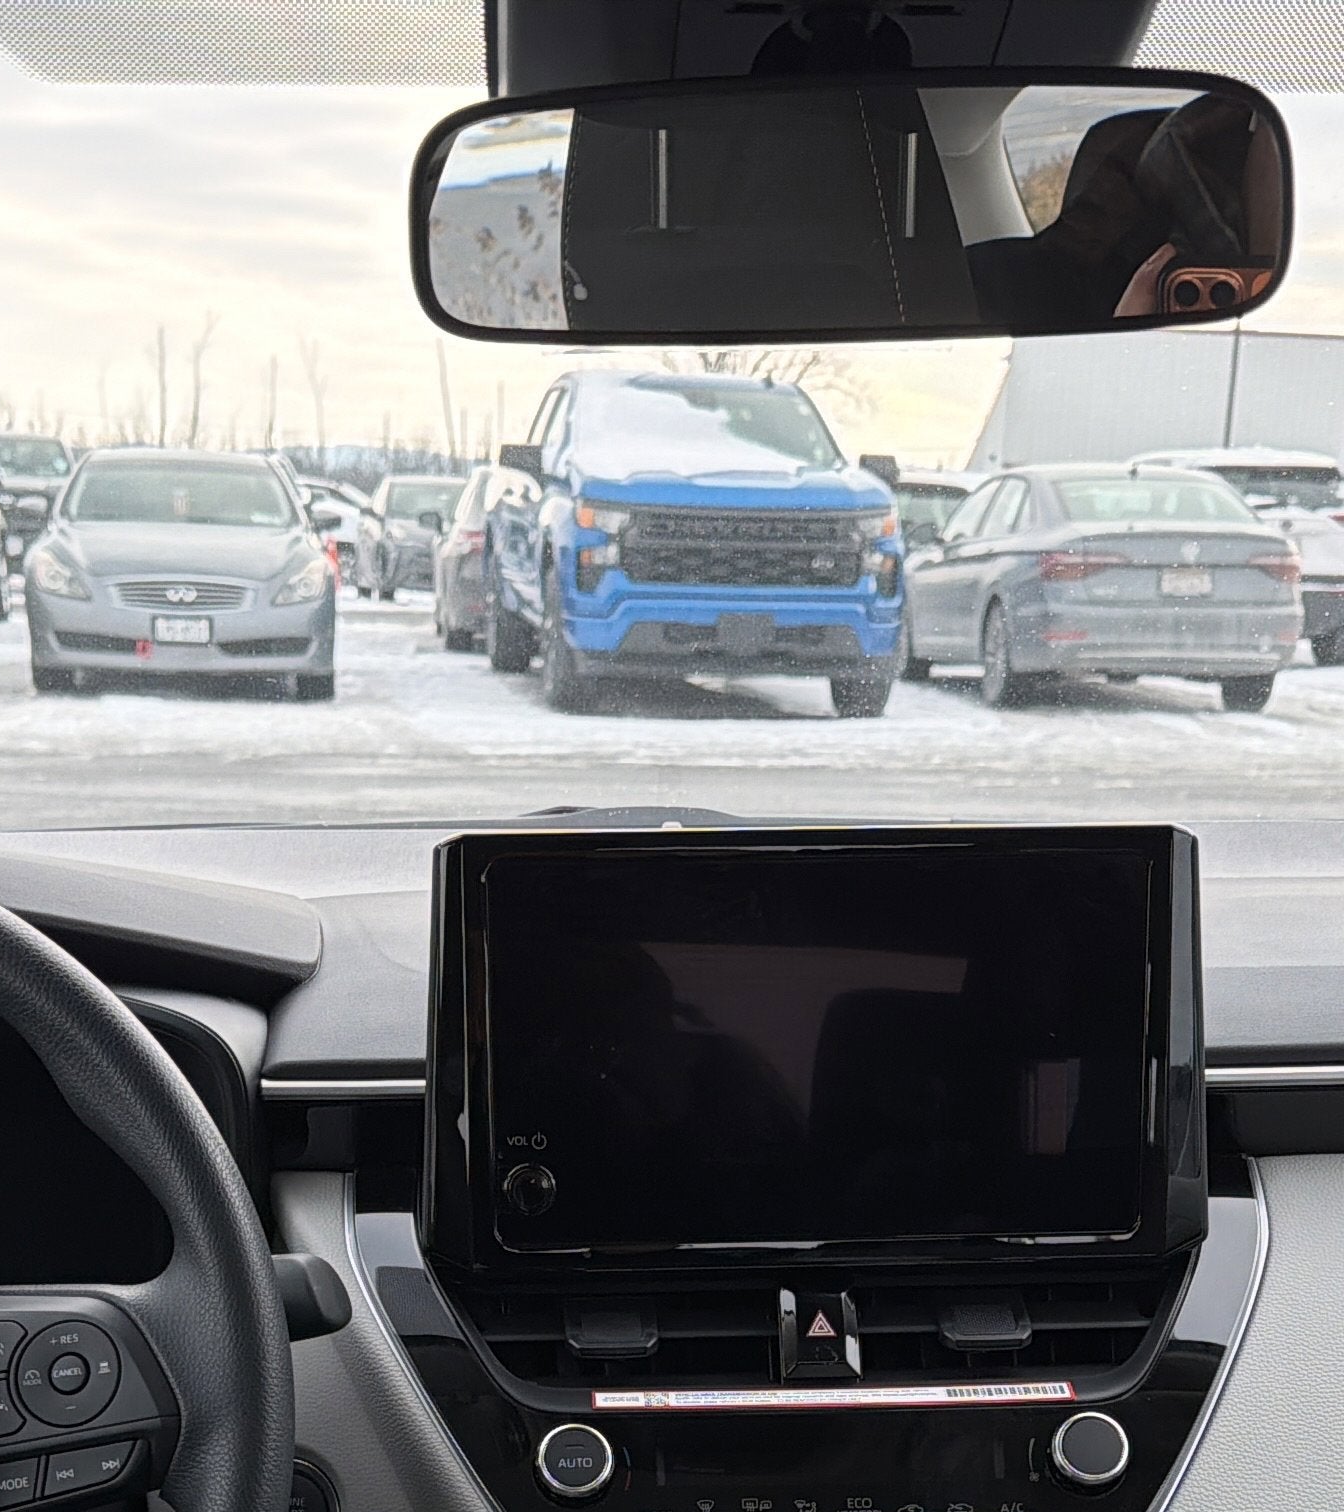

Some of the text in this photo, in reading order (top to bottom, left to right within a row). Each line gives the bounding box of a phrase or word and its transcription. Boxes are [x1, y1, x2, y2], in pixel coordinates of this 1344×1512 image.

[506, 1135, 529, 1146] VOL
[59, 1333, 79, 1345] RES
[53, 1366, 83, 1378] CANCEL
[558, 1457, 594, 1469] AUTO
[846, 1498, 873, 1510] ECO
